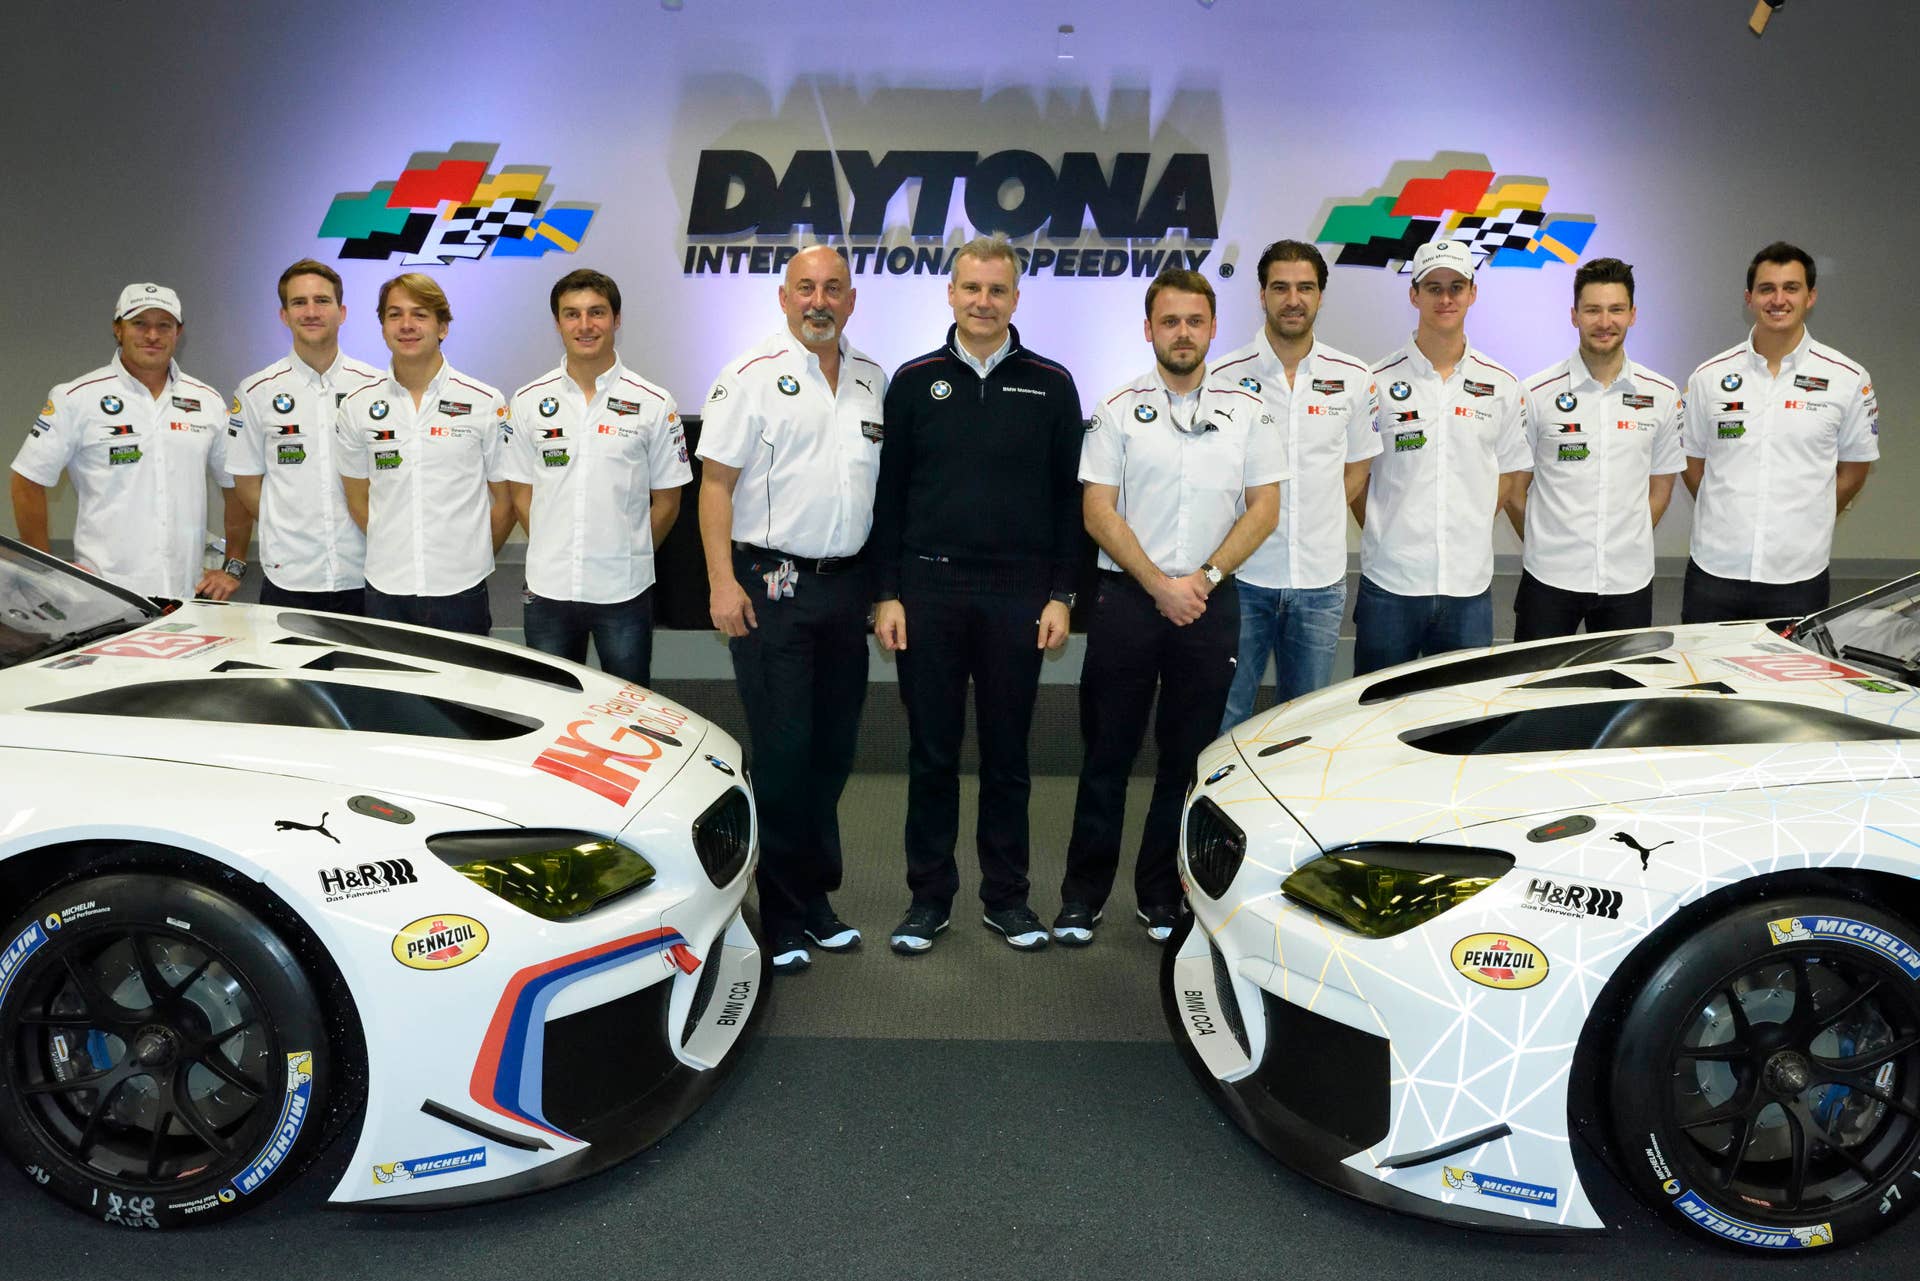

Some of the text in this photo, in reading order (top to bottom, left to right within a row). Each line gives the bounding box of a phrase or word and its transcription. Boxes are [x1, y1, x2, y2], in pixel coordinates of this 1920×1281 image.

[687, 150, 1219, 238] DAYTONA
[684, 245, 957, 274] INTERTION
[637, 706, 690, 735] Club
[531, 720, 663, 807] IHG
[319, 864, 385, 894] H&R
[61, 901, 95, 917] MICHELIN
[326, 887, 390, 903] Das Fahrwerk!
[1525, 878, 1588, 912] H&R
[63, 906, 111, 923] Total Performance
[1520, 903, 1585, 919] Das Fahrwerk!
[0, 926, 38, 985] ELIN
[407, 924, 476, 959] PENNZOIL
[1815, 919, 1920, 969] MICHELIN
[1463, 951, 1535, 969] PENNZOIL
[717, 981, 752, 1025] BMW CCA
[1184, 990, 1216, 1036] BMW CCA
[243, 1094, 305, 1190] MICHELIN
[413, 1152, 484, 1172] MICHELIN
[1482, 1180, 1555, 1200] MICHELIN
[184, 1200, 219, 1214] MICHELIN
[1680, 1200, 1789, 1247] MICHELIN
